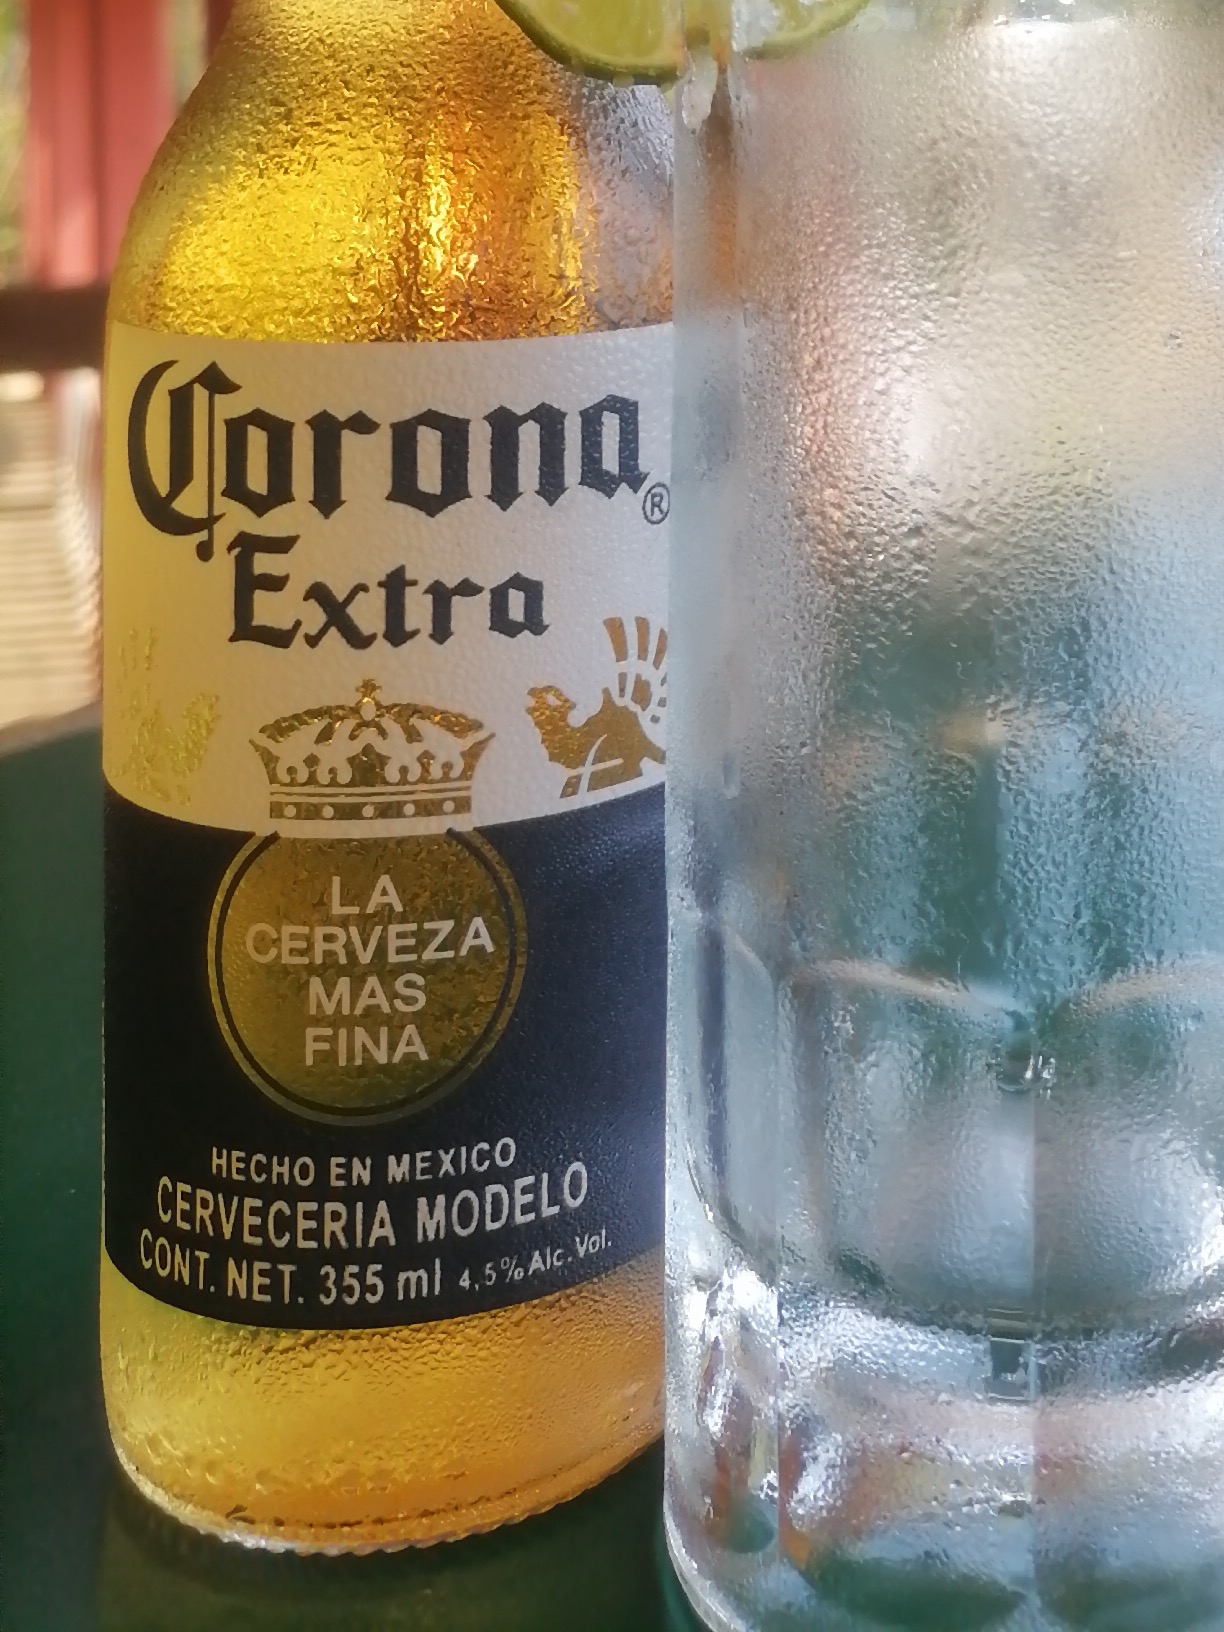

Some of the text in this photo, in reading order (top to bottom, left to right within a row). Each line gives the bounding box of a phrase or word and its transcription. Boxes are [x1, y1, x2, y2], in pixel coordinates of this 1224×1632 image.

[127, 360, 649, 562] Corona
[227, 531, 549, 650] Extra
[331, 874, 403, 915] LA
[245, 916, 495, 966] CERVEZA
[308, 972, 427, 1016] MAS
[304, 1024, 428, 1067] FINA
[211, 1136, 516, 1188] HECHO EN MEXICO
[157, 1160, 588, 1250] CERVECERIA MODELO
[139, 1227, 215, 1294] CONT.
[227, 1259, 304, 1305] NET.
[319, 1266, 384, 1306] 355
[397, 1258, 441, 1300] ml
